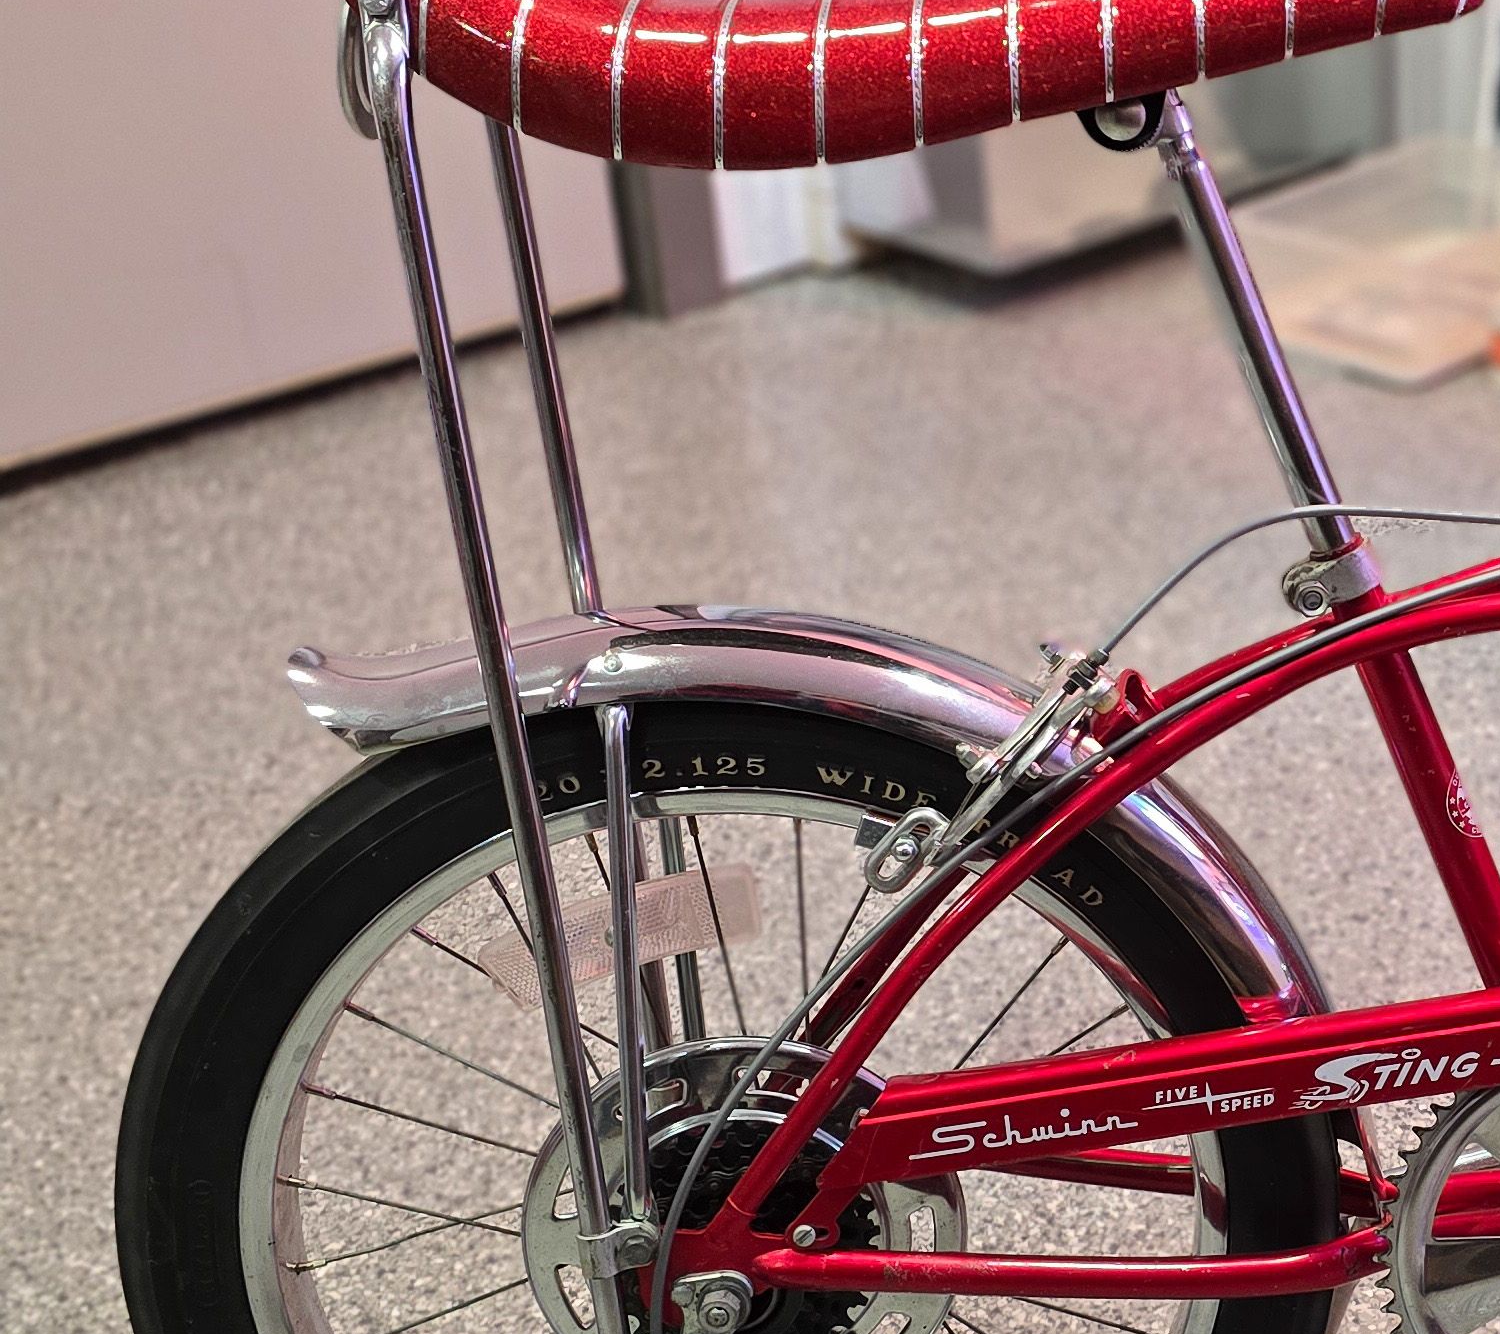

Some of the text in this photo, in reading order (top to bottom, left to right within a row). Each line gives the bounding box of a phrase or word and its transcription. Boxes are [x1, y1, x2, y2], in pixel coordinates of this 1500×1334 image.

[641, 756, 767, 780] 2.125
[972, 817, 1105, 907] TRAD
[1155, 1085, 1275, 1113] FIVE SPEED
[908, 1108, 1139, 1161] Schwinn
